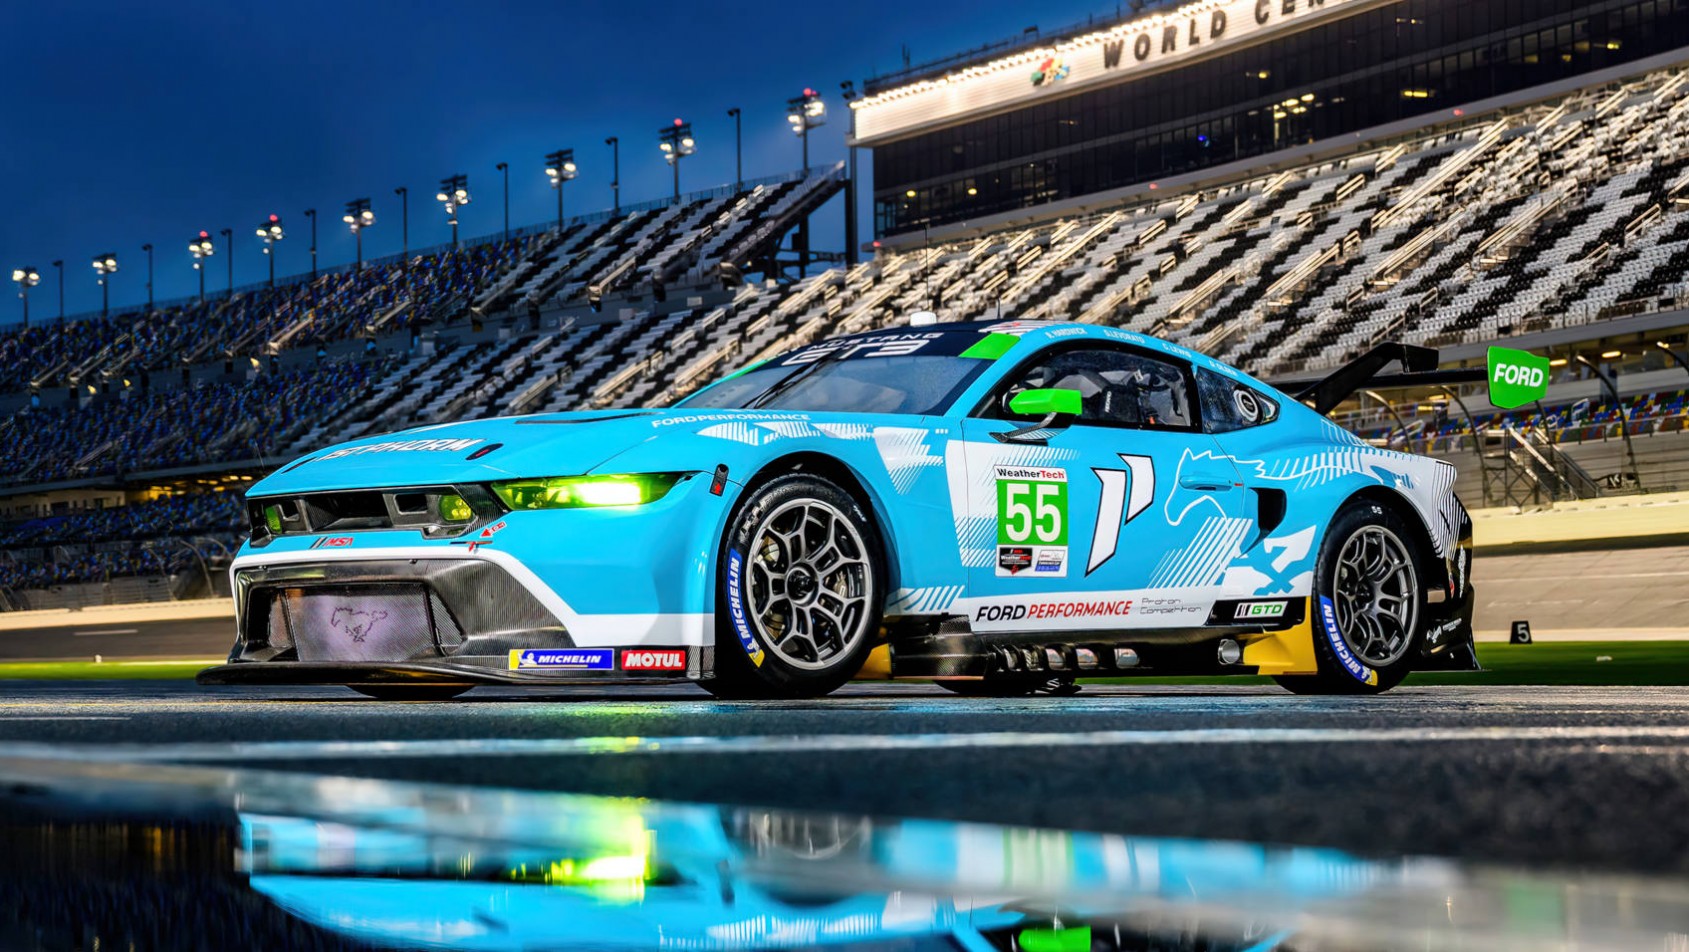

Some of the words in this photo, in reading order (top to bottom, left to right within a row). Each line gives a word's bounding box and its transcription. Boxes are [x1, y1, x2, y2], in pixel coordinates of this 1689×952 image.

[1103, 10, 1226, 69] WORLD
[780, 339, 931, 366] GT3
[1493, 363, 1544, 387] FORD
[996, 468, 1065, 479] WeatherTech
[1005, 483, 1062, 542] 55
[729, 557, 751, 639] MICHELIN
[1251, 604, 1283, 615] GTD
[1323, 604, 1361, 674] MICHELIN
[1517, 623, 1530, 642] 5
[537, 655, 602, 664] MICHELIN
[625, 652, 682, 667] MOTUL
